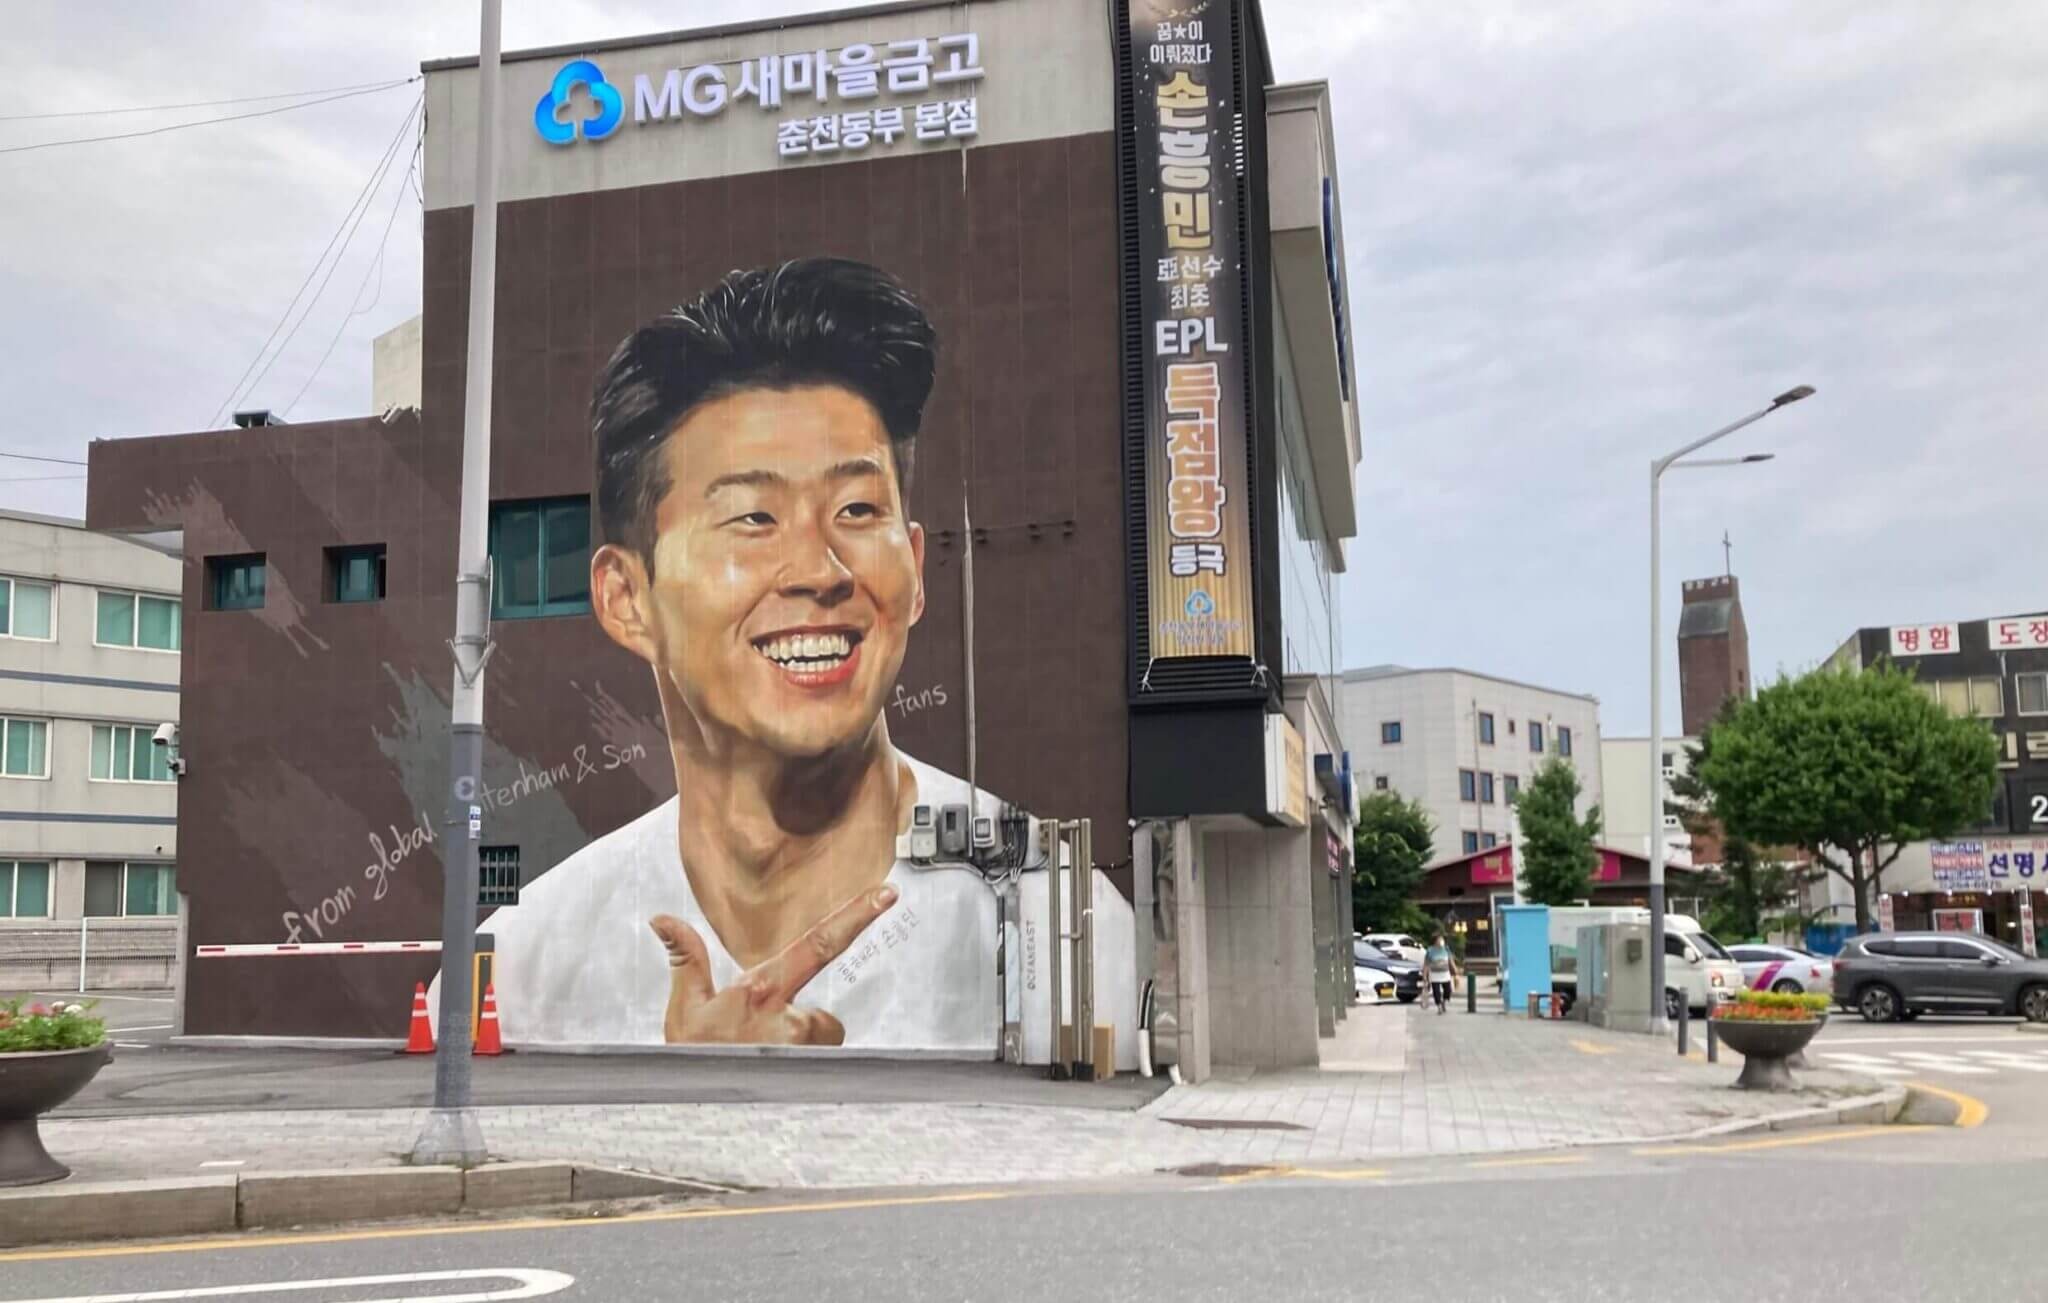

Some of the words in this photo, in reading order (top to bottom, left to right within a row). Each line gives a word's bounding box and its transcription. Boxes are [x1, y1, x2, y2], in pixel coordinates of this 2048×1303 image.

[1150, 42, 1213, 64] 이뤄졌다
[777, 106, 905, 157] 춘천동부
[914, 98, 978, 142] 본점
[1157, 71, 1212, 249] 손흥민
[1171, 283, 1210, 310] 최초
[1155, 317, 1229, 356] EPL
[1166, 363, 1226, 538] 득점왕
[1170, 544, 1226, 576] 등극
[282, 885, 356, 945] from
[365, 811, 438, 900] global
[573, 744, 598, 785] &
[603, 744, 646, 770] Son
[892, 684, 948, 718] fans
